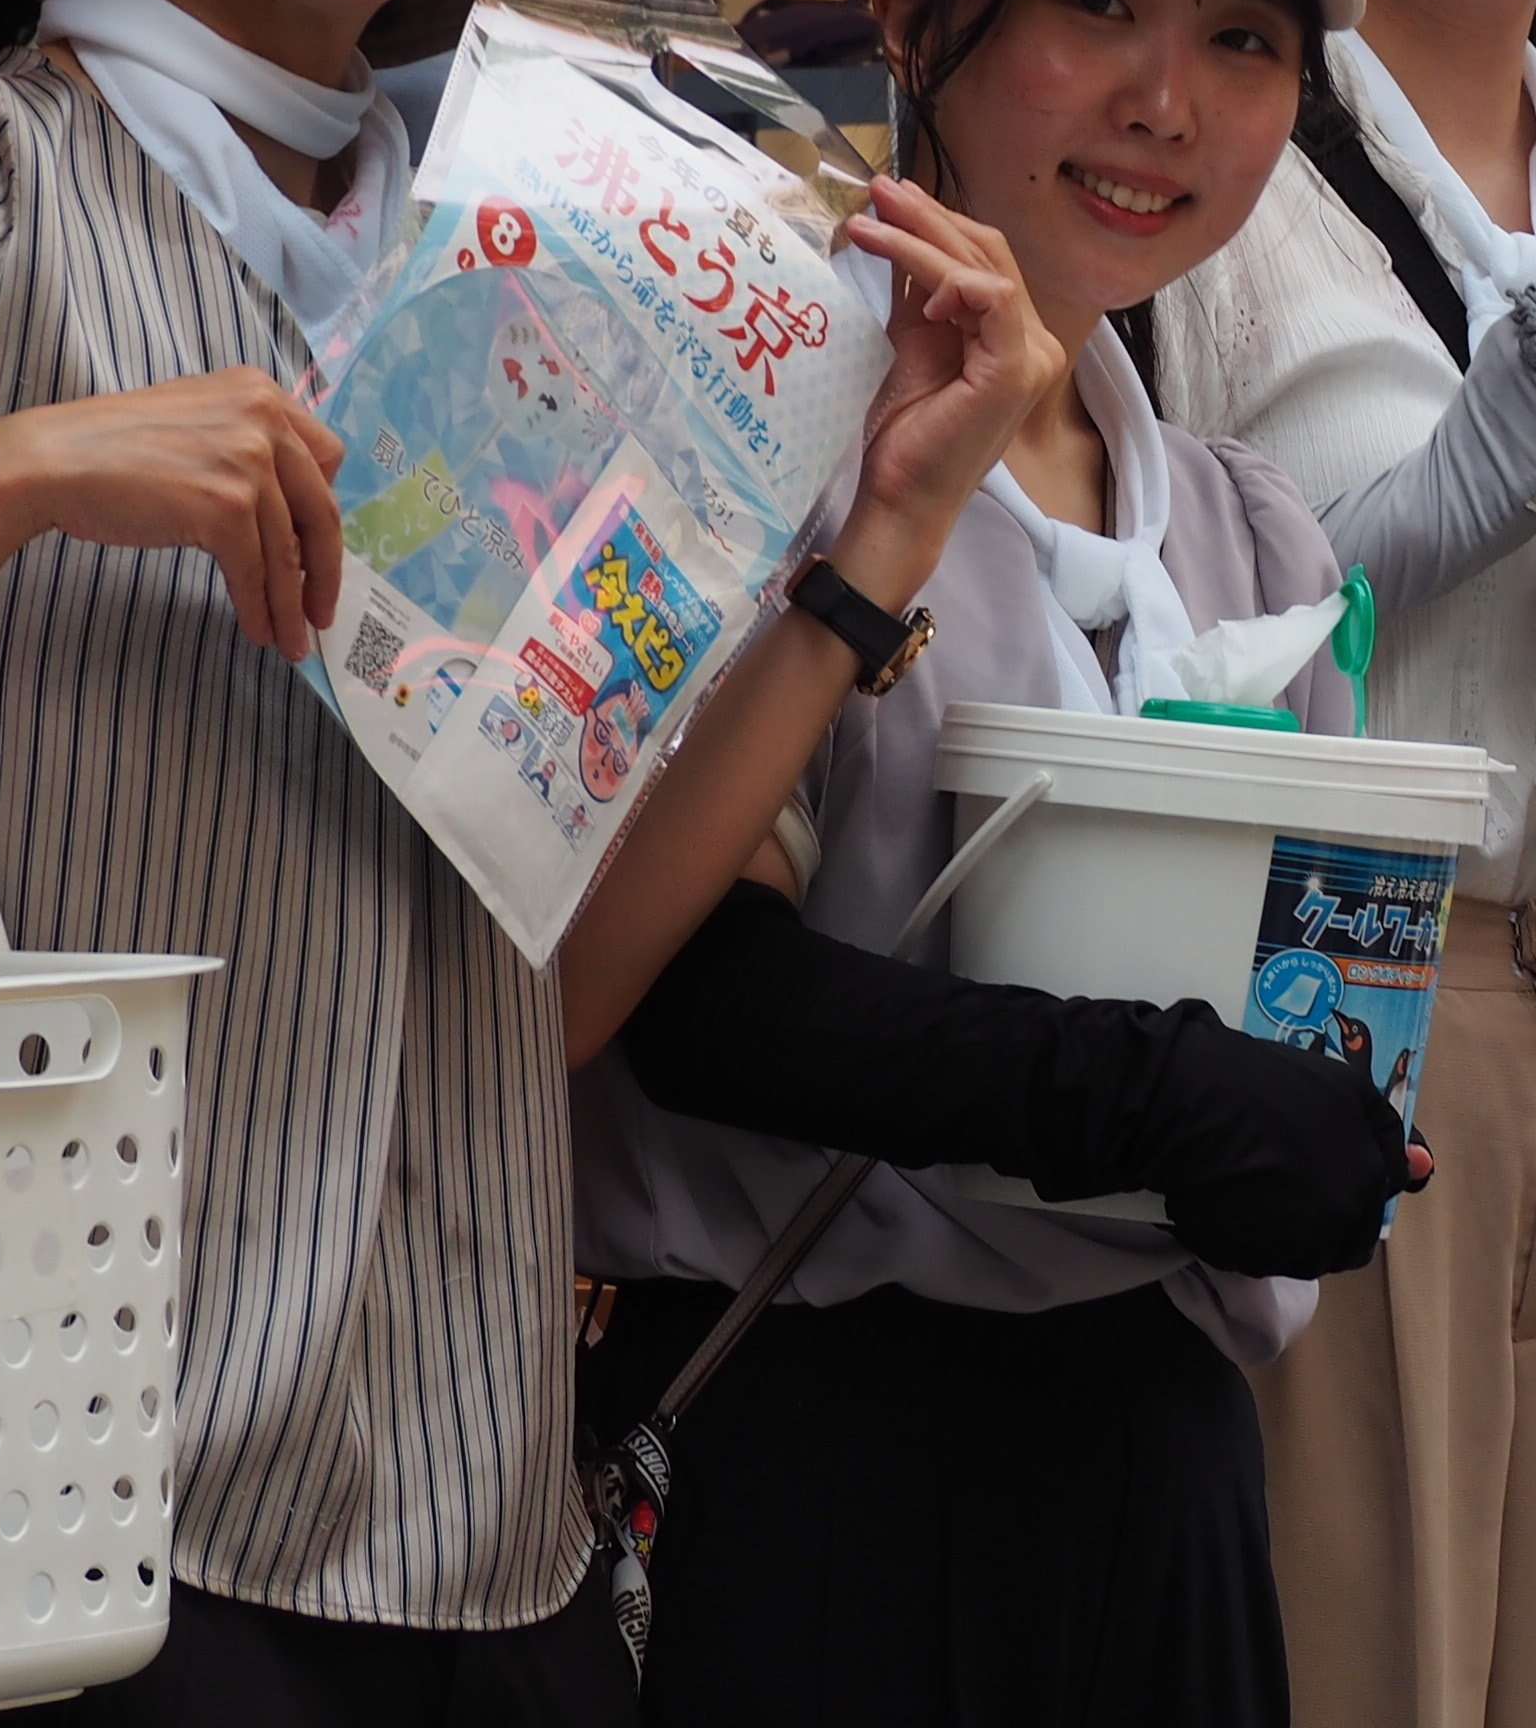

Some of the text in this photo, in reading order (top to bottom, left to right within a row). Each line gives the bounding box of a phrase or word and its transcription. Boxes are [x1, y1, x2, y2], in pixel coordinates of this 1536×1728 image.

[637, 133, 777, 266] 今年の夏も
[371, 427, 525, 571] 扇いでひと涼み
[584, 544, 686, 693] 冷えピタ
